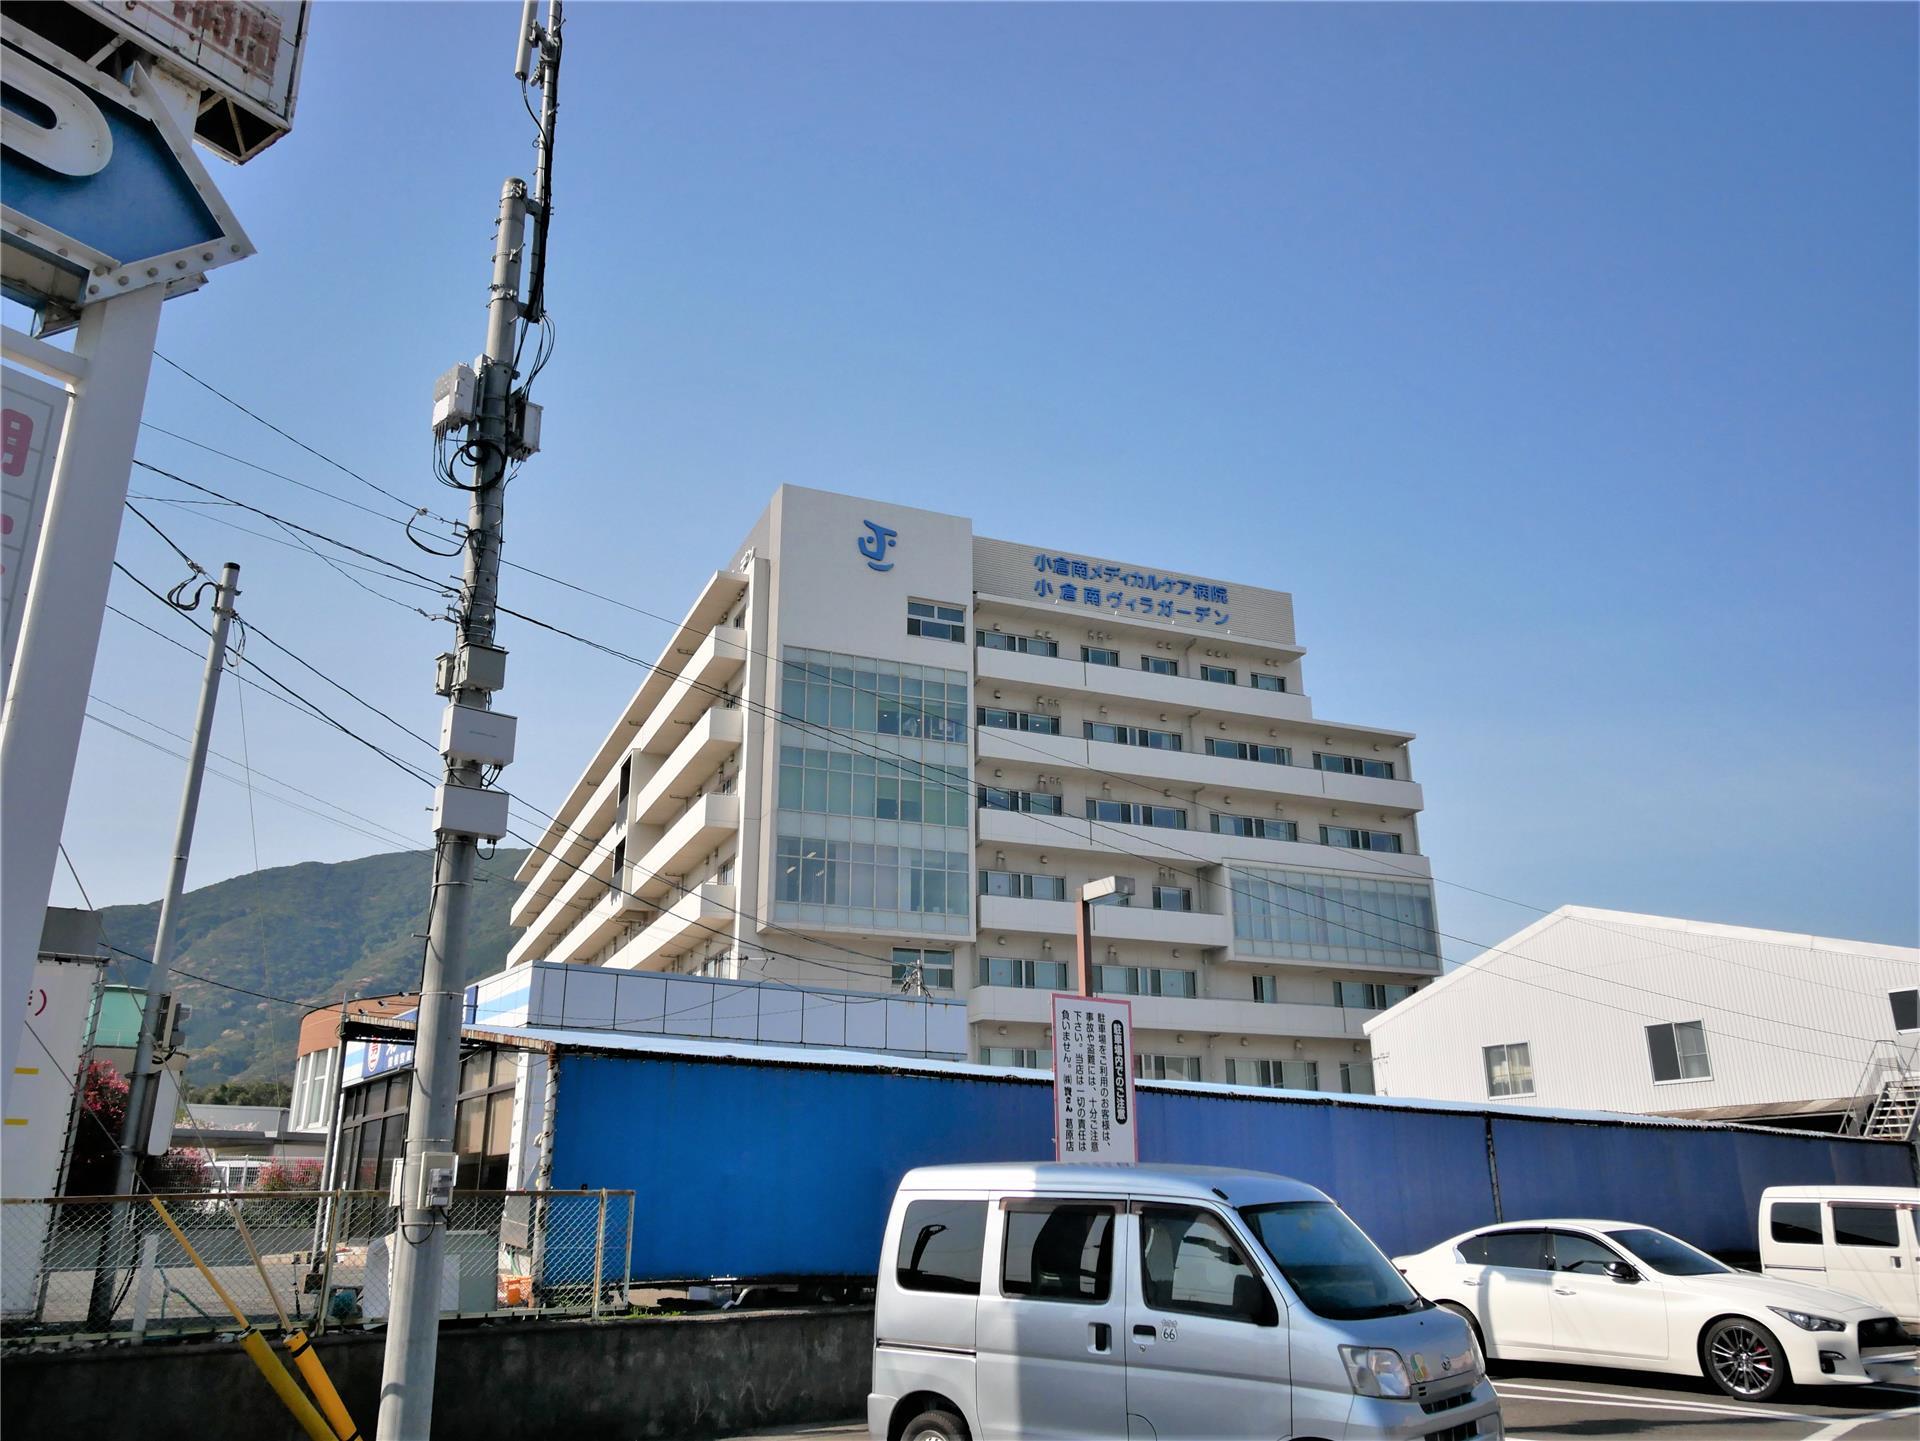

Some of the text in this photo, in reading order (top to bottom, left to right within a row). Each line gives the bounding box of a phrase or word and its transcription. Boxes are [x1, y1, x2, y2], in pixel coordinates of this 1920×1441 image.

[1034, 553, 1229, 604] 小倉南メディカルケア病院
[1112, 1022, 1126, 1121] 駐車場内でのご注意
[1163, 1327, 1176, 1340] 66
